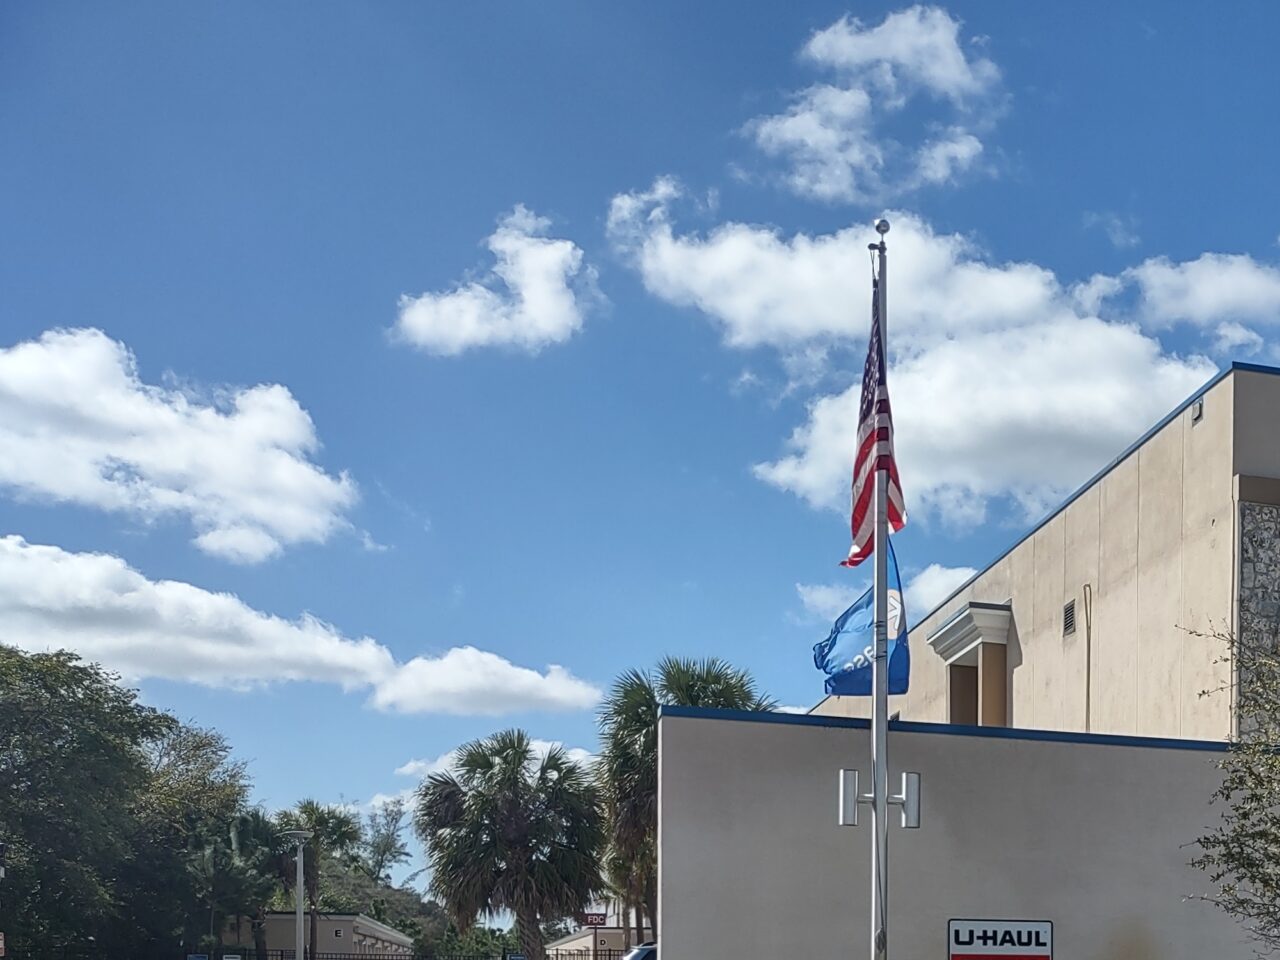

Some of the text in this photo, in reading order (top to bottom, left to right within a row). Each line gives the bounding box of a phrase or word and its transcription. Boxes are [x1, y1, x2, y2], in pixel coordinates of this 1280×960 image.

[587, 915, 605, 924] FDC
[334, 929, 342, 938] E
[953, 929, 1047, 947] U-HAUL
